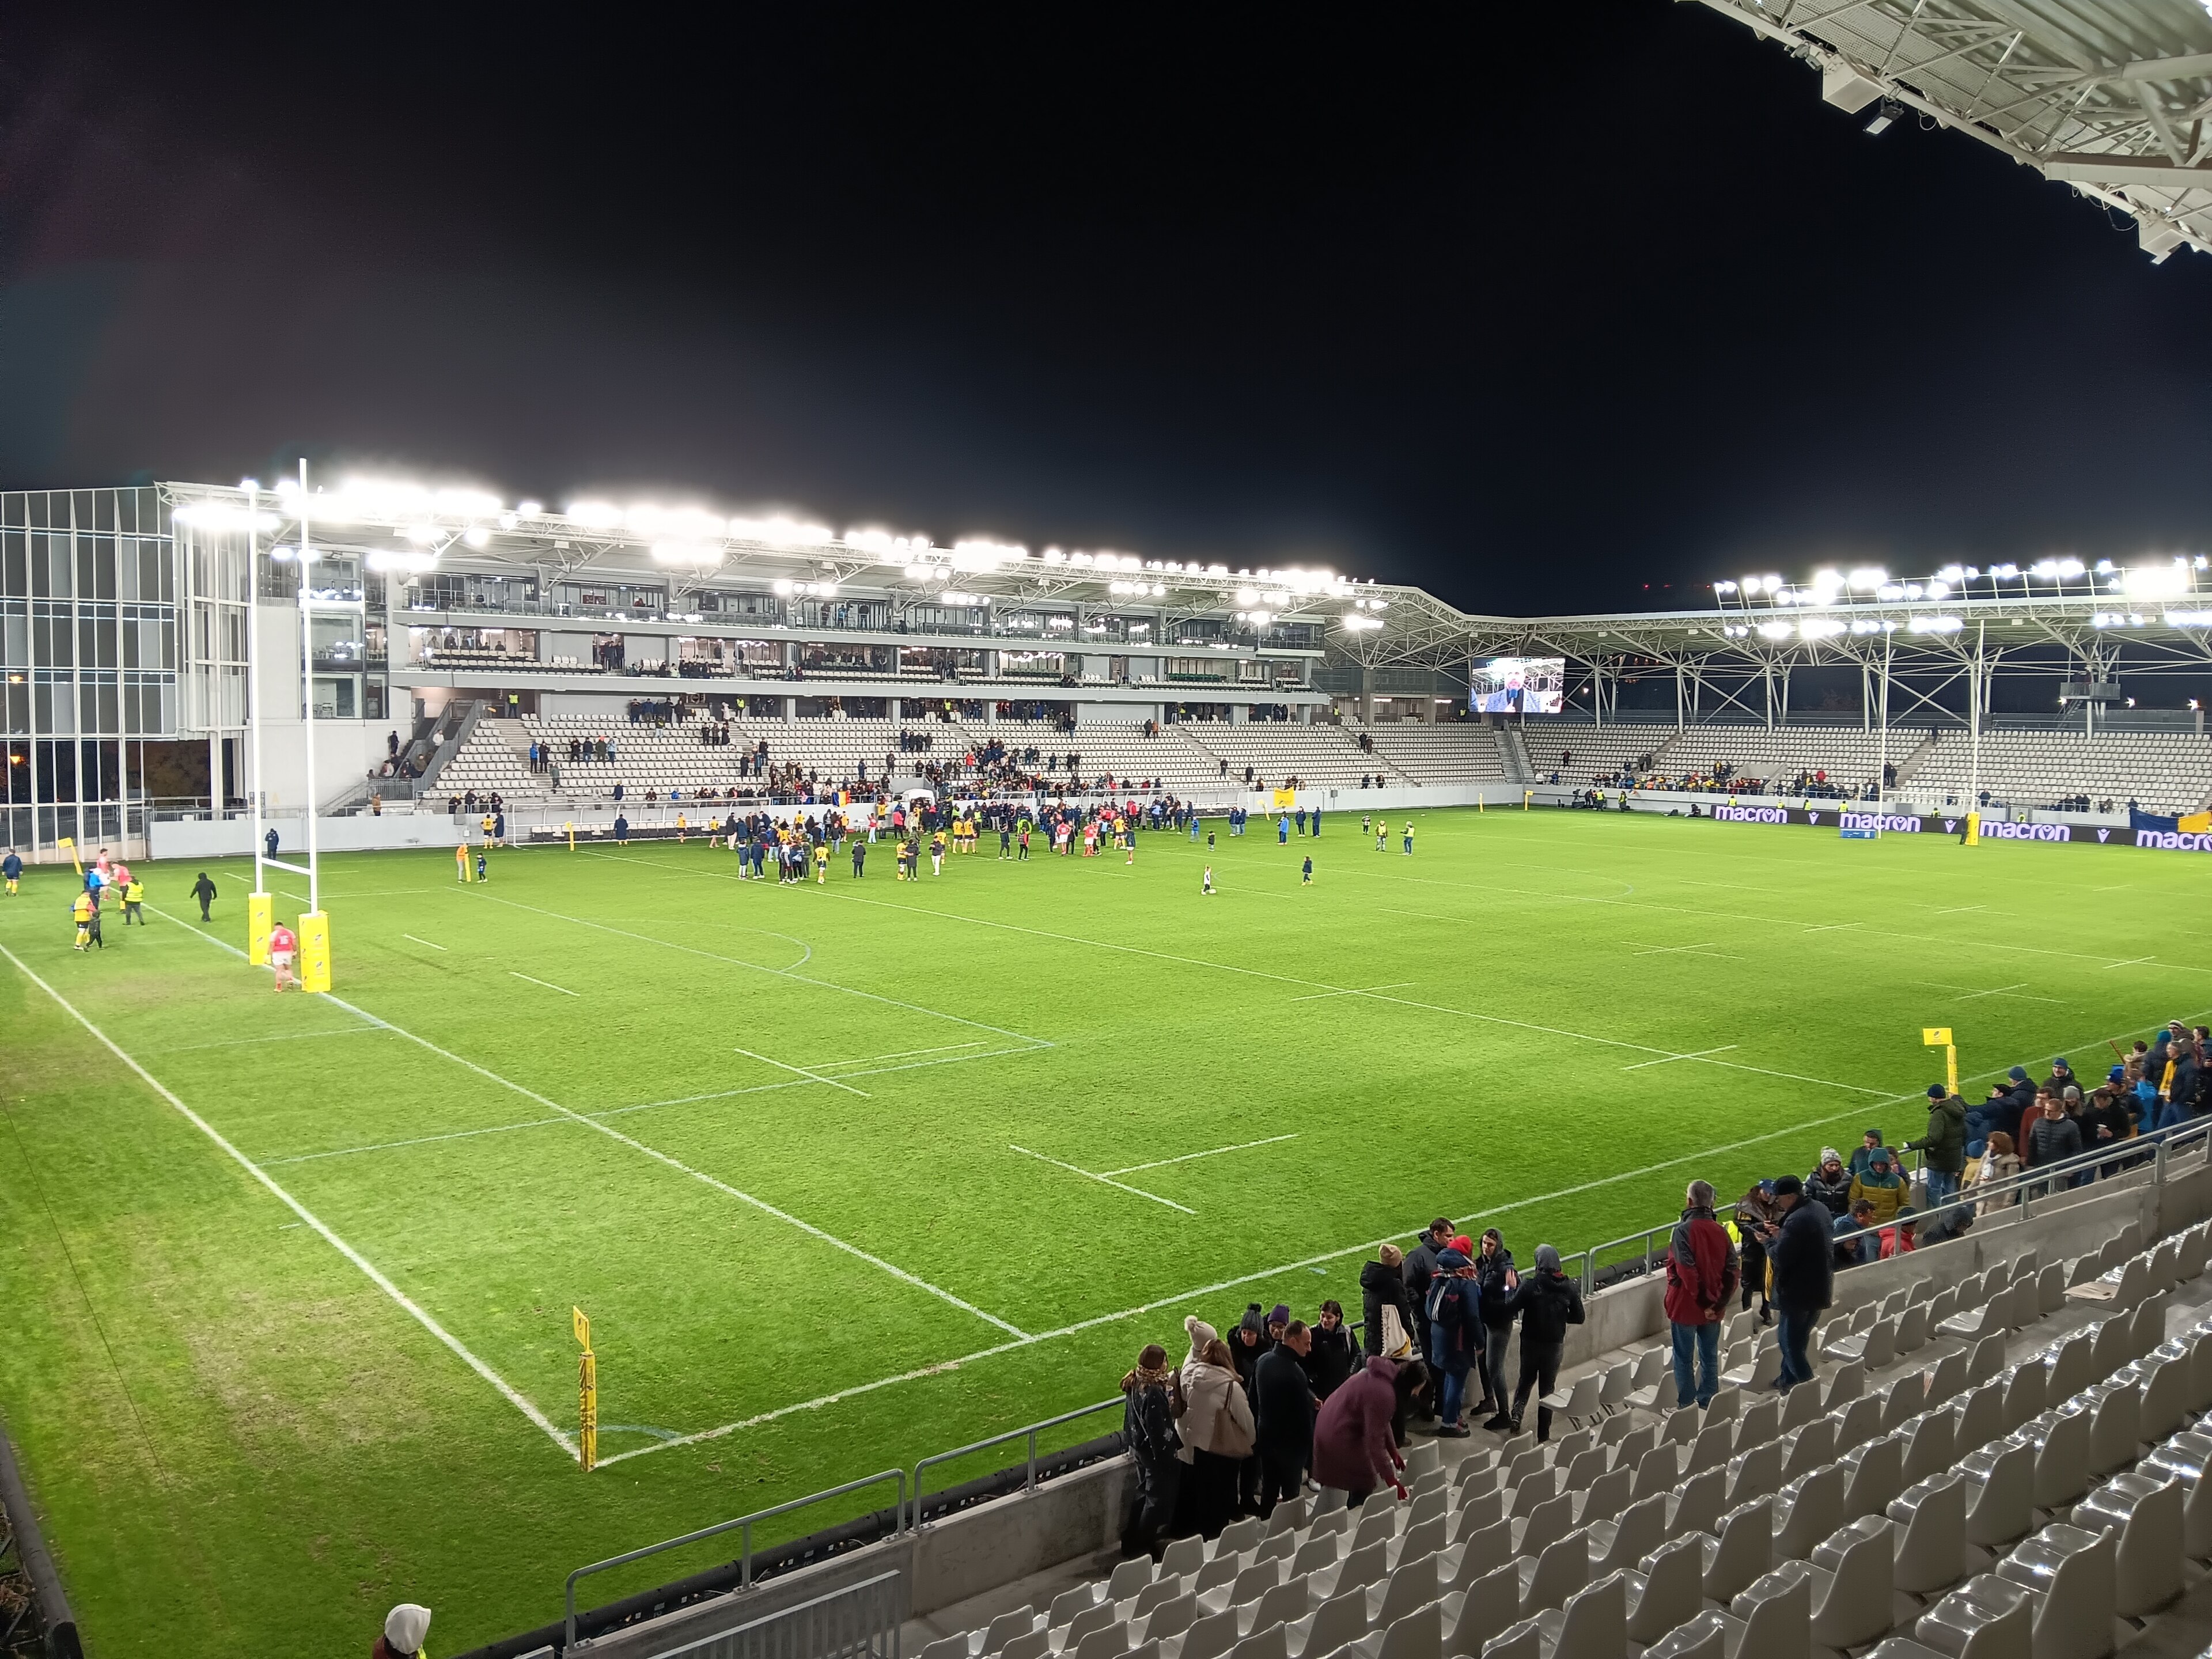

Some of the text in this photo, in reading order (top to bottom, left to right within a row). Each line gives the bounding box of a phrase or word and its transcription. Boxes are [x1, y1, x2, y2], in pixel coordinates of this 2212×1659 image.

[1715, 806, 1787, 824] macron
[1839, 813, 1921, 832] macron
[1979, 821, 2071, 842] macron
